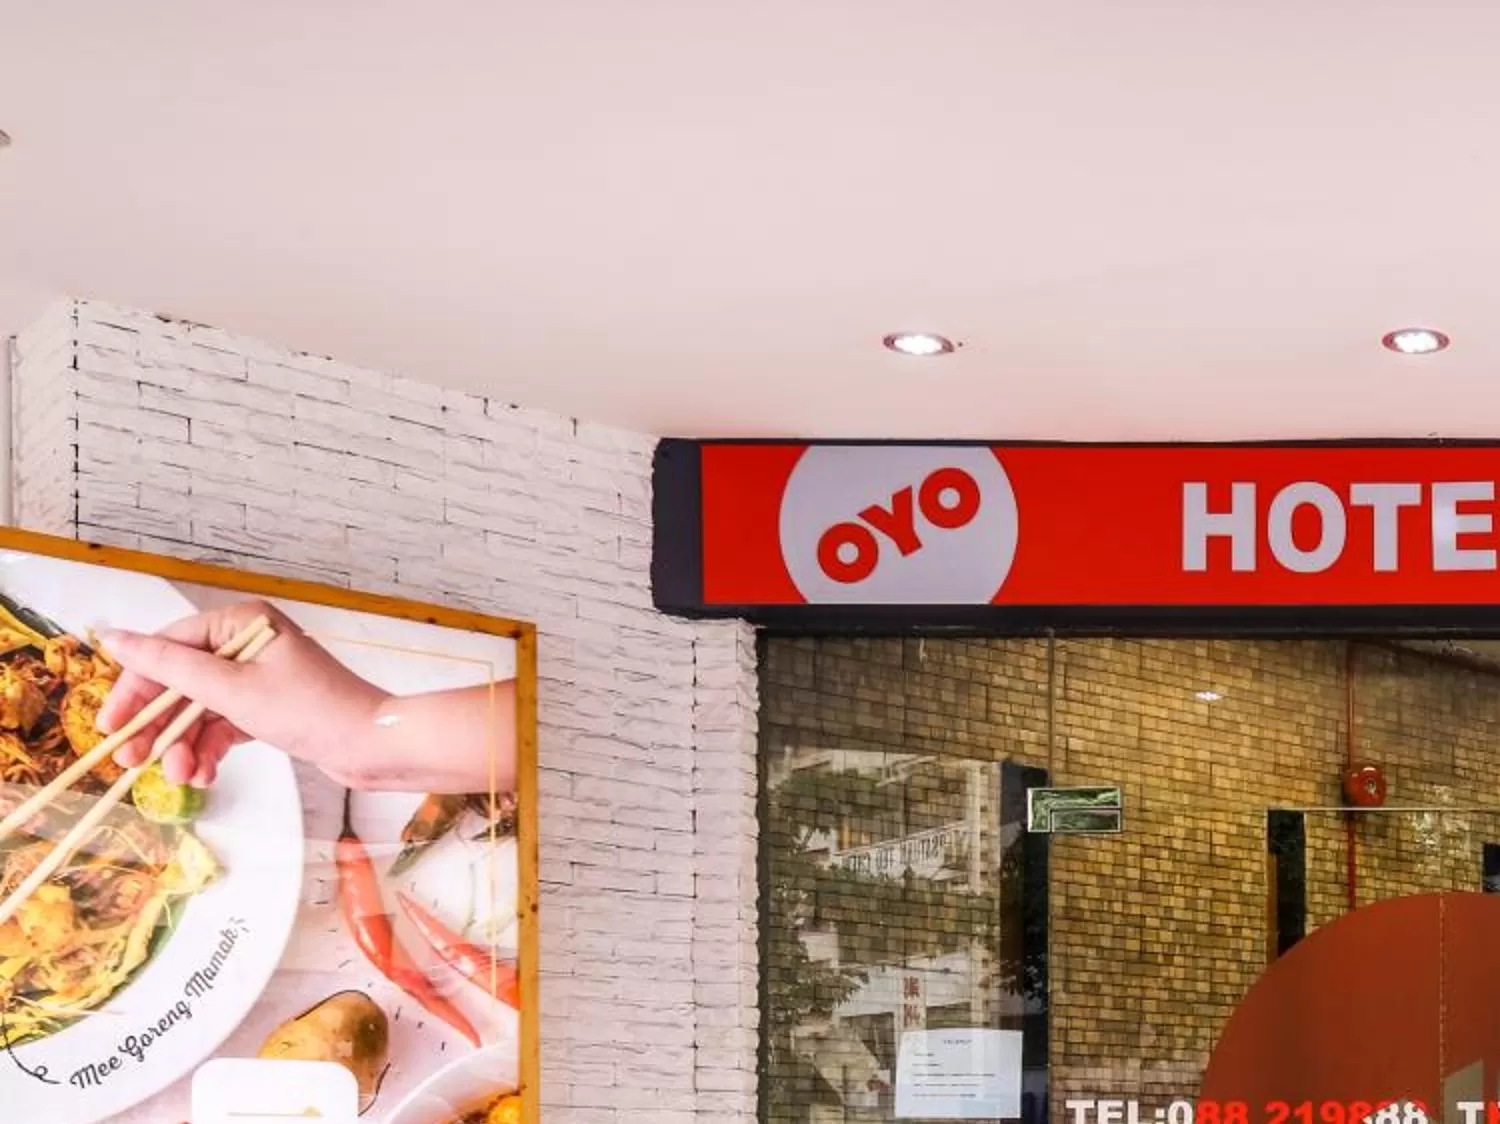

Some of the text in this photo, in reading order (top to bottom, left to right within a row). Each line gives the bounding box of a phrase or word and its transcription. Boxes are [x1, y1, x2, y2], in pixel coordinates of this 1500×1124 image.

[816, 467, 981, 583] OYO
[69, 927, 239, 1089] Mee Goreng Mamak
